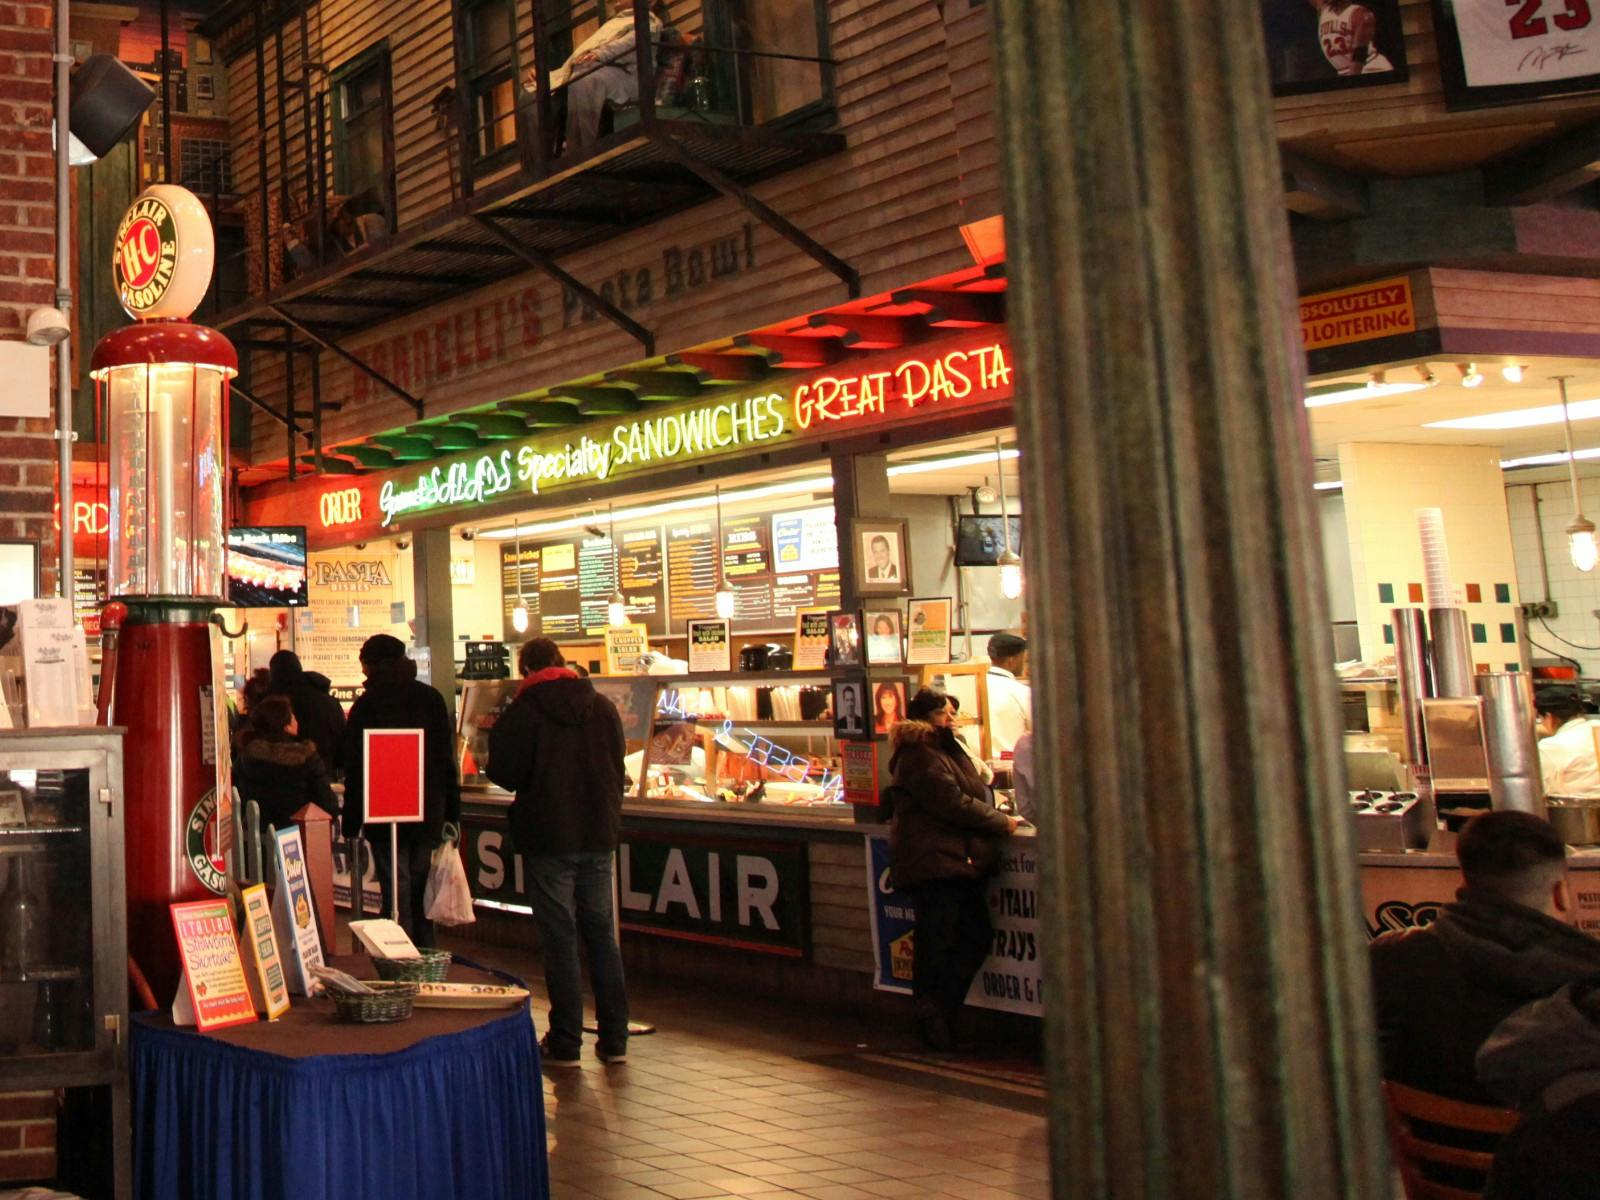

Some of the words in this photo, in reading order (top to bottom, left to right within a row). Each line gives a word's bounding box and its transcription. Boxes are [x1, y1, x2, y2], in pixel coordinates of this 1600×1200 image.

[1508, 0, 1591, 39] 23
[1322, 37, 1348, 57] 23
[116, 201, 167, 264] SINCLAIR
[121, 241, 175, 308] GASOLINE
[662, 222, 754, 300] Bowl
[1313, 309, 1410, 342] LOITERING
[319, 487, 362, 527] ORDER
[517, 436, 611, 494] Specialty
[613, 393, 782, 464] SANDWICHES
[795, 371, 892, 429] GREAT
[894, 344, 1012, 407] PASTA
[315, 560, 392, 586] PASTA
[476, 830, 782, 932] SILAIR
[884, 905, 903, 919] YOUR
[1000, 887, 1040, 919] ITALI
[983, 971, 1021, 1001] ORDER
[1023, 980, 1033, 1002] &
